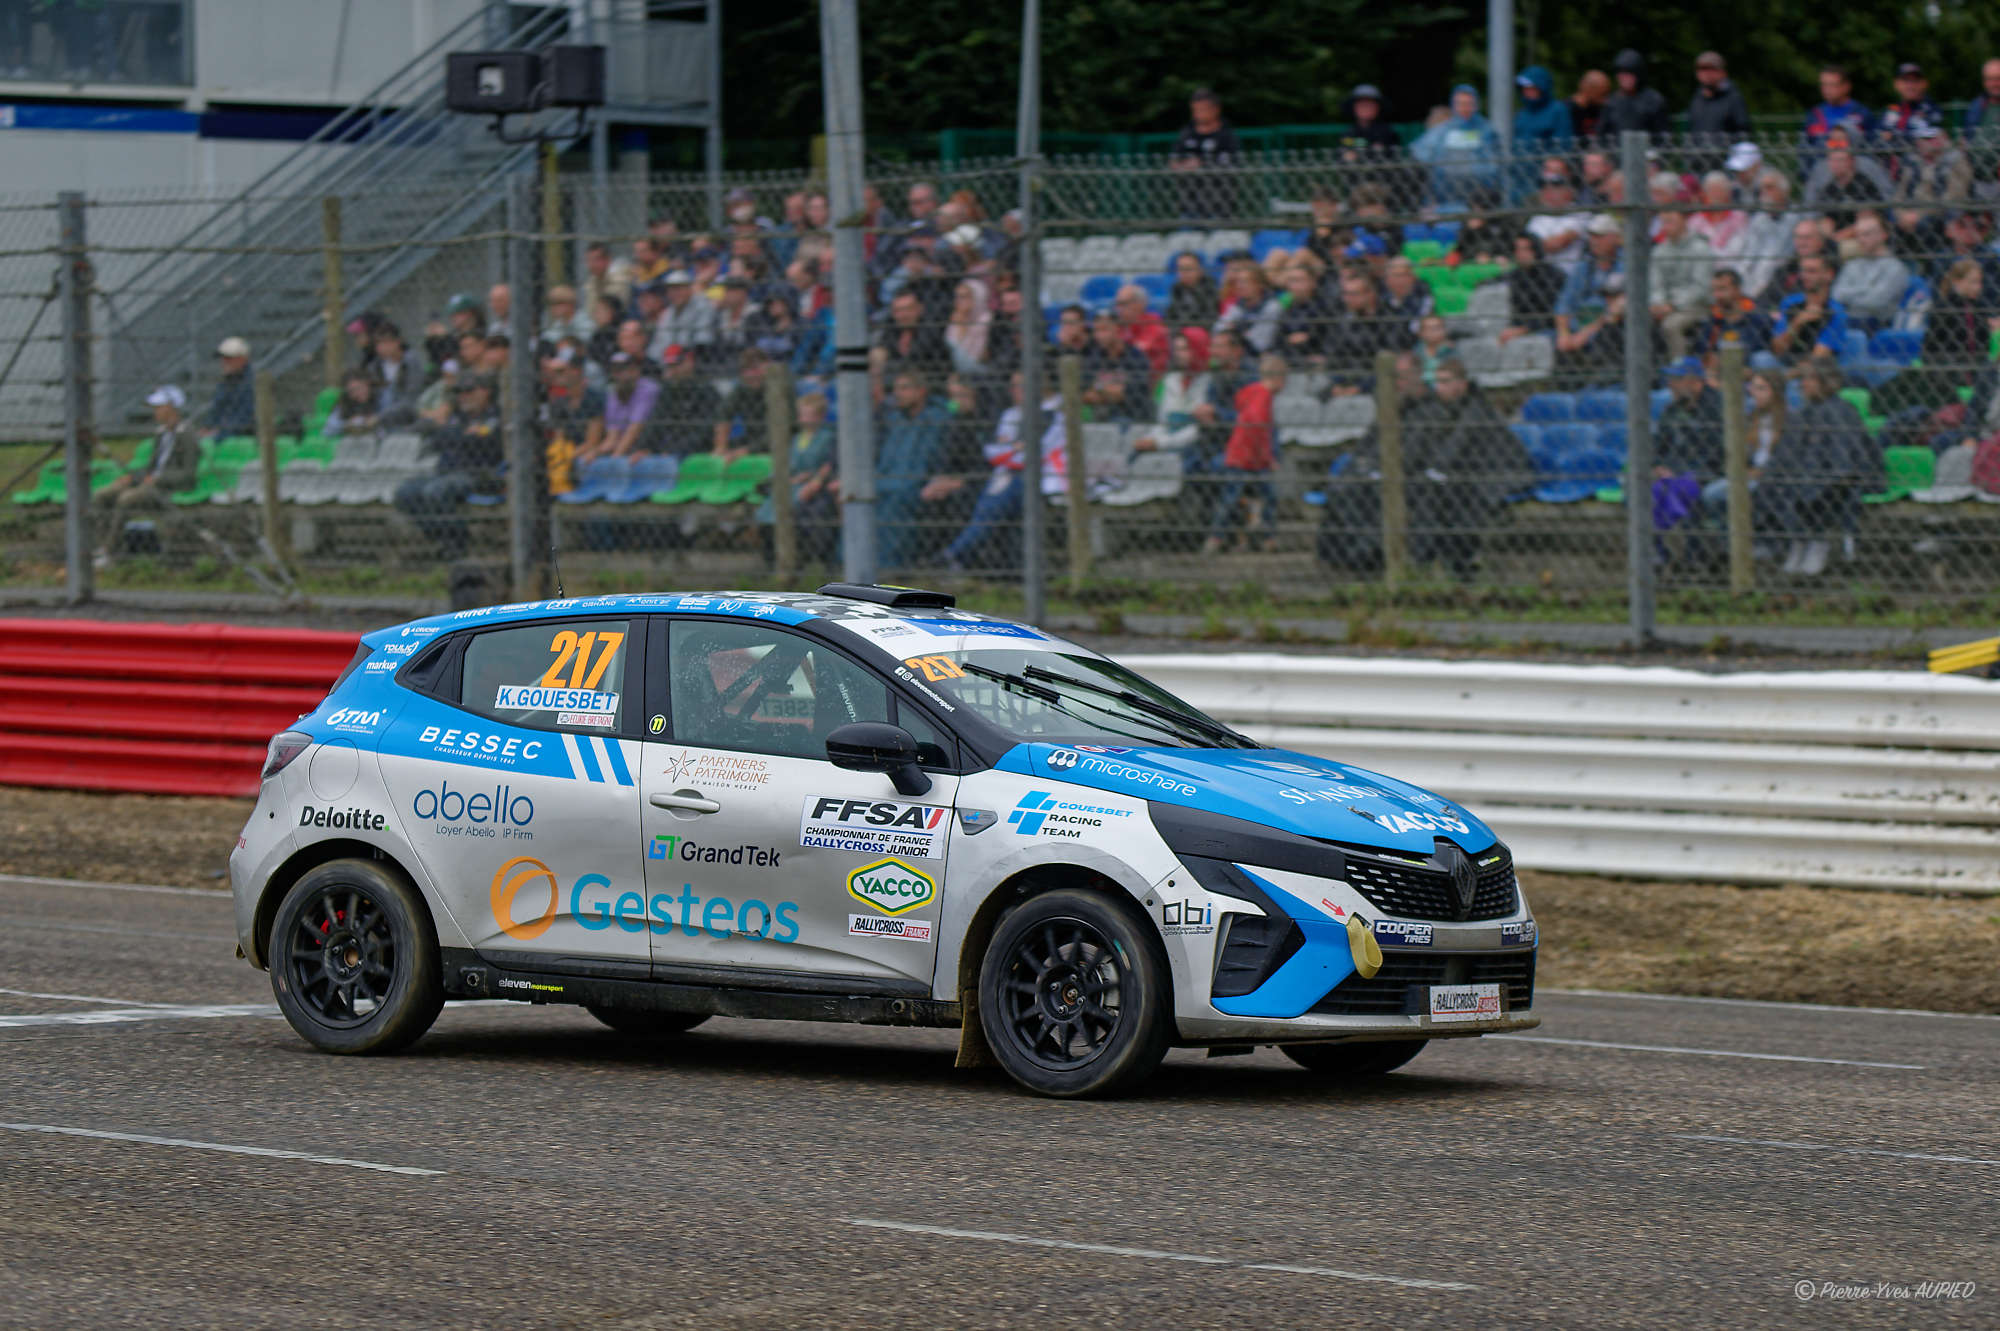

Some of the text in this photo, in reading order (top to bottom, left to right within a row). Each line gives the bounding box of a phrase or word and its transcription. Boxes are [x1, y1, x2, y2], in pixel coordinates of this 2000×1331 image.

[366, 659, 397, 672] markup
[540, 630, 624, 689] 217
[905, 655, 966, 682] 217
[499, 688, 616, 711] K.GOUESBET
[419, 726, 542, 760] BESSEC
[434, 746, 472, 758] CHAUSSEUR
[474, 752, 497, 762] DEPUIS
[700, 755, 767, 771] PARTNERS
[694, 767, 772, 784] PATRIMOINE
[1081, 758, 1198, 796] microshare
[413, 780, 534, 826] abello
[1058, 802, 1133, 817] GOUESBET
[811, 798, 925, 829] FFSA
[1049, 814, 1102, 827] RACING
[1374, 811, 1470, 834] YACCO
[436, 824, 533, 840] Loyer Abello IP Firm
[805, 827, 932, 846] CHAMPIONNAT DE FRANCE
[1042, 827, 1081, 838] TEAM
[803, 837, 929, 857] RALLYCROSS JUNIOR
[859, 876, 925, 898] YACCO
[570, 873, 800, 943] Gesteos
[854, 917, 929, 938] RALLYCROSS FRANCE
[1376, 922, 1432, 935] COOPER
[1404, 935, 1431, 944] TIRES
[1436, 992, 1478, 1010] RALLYCROSS
